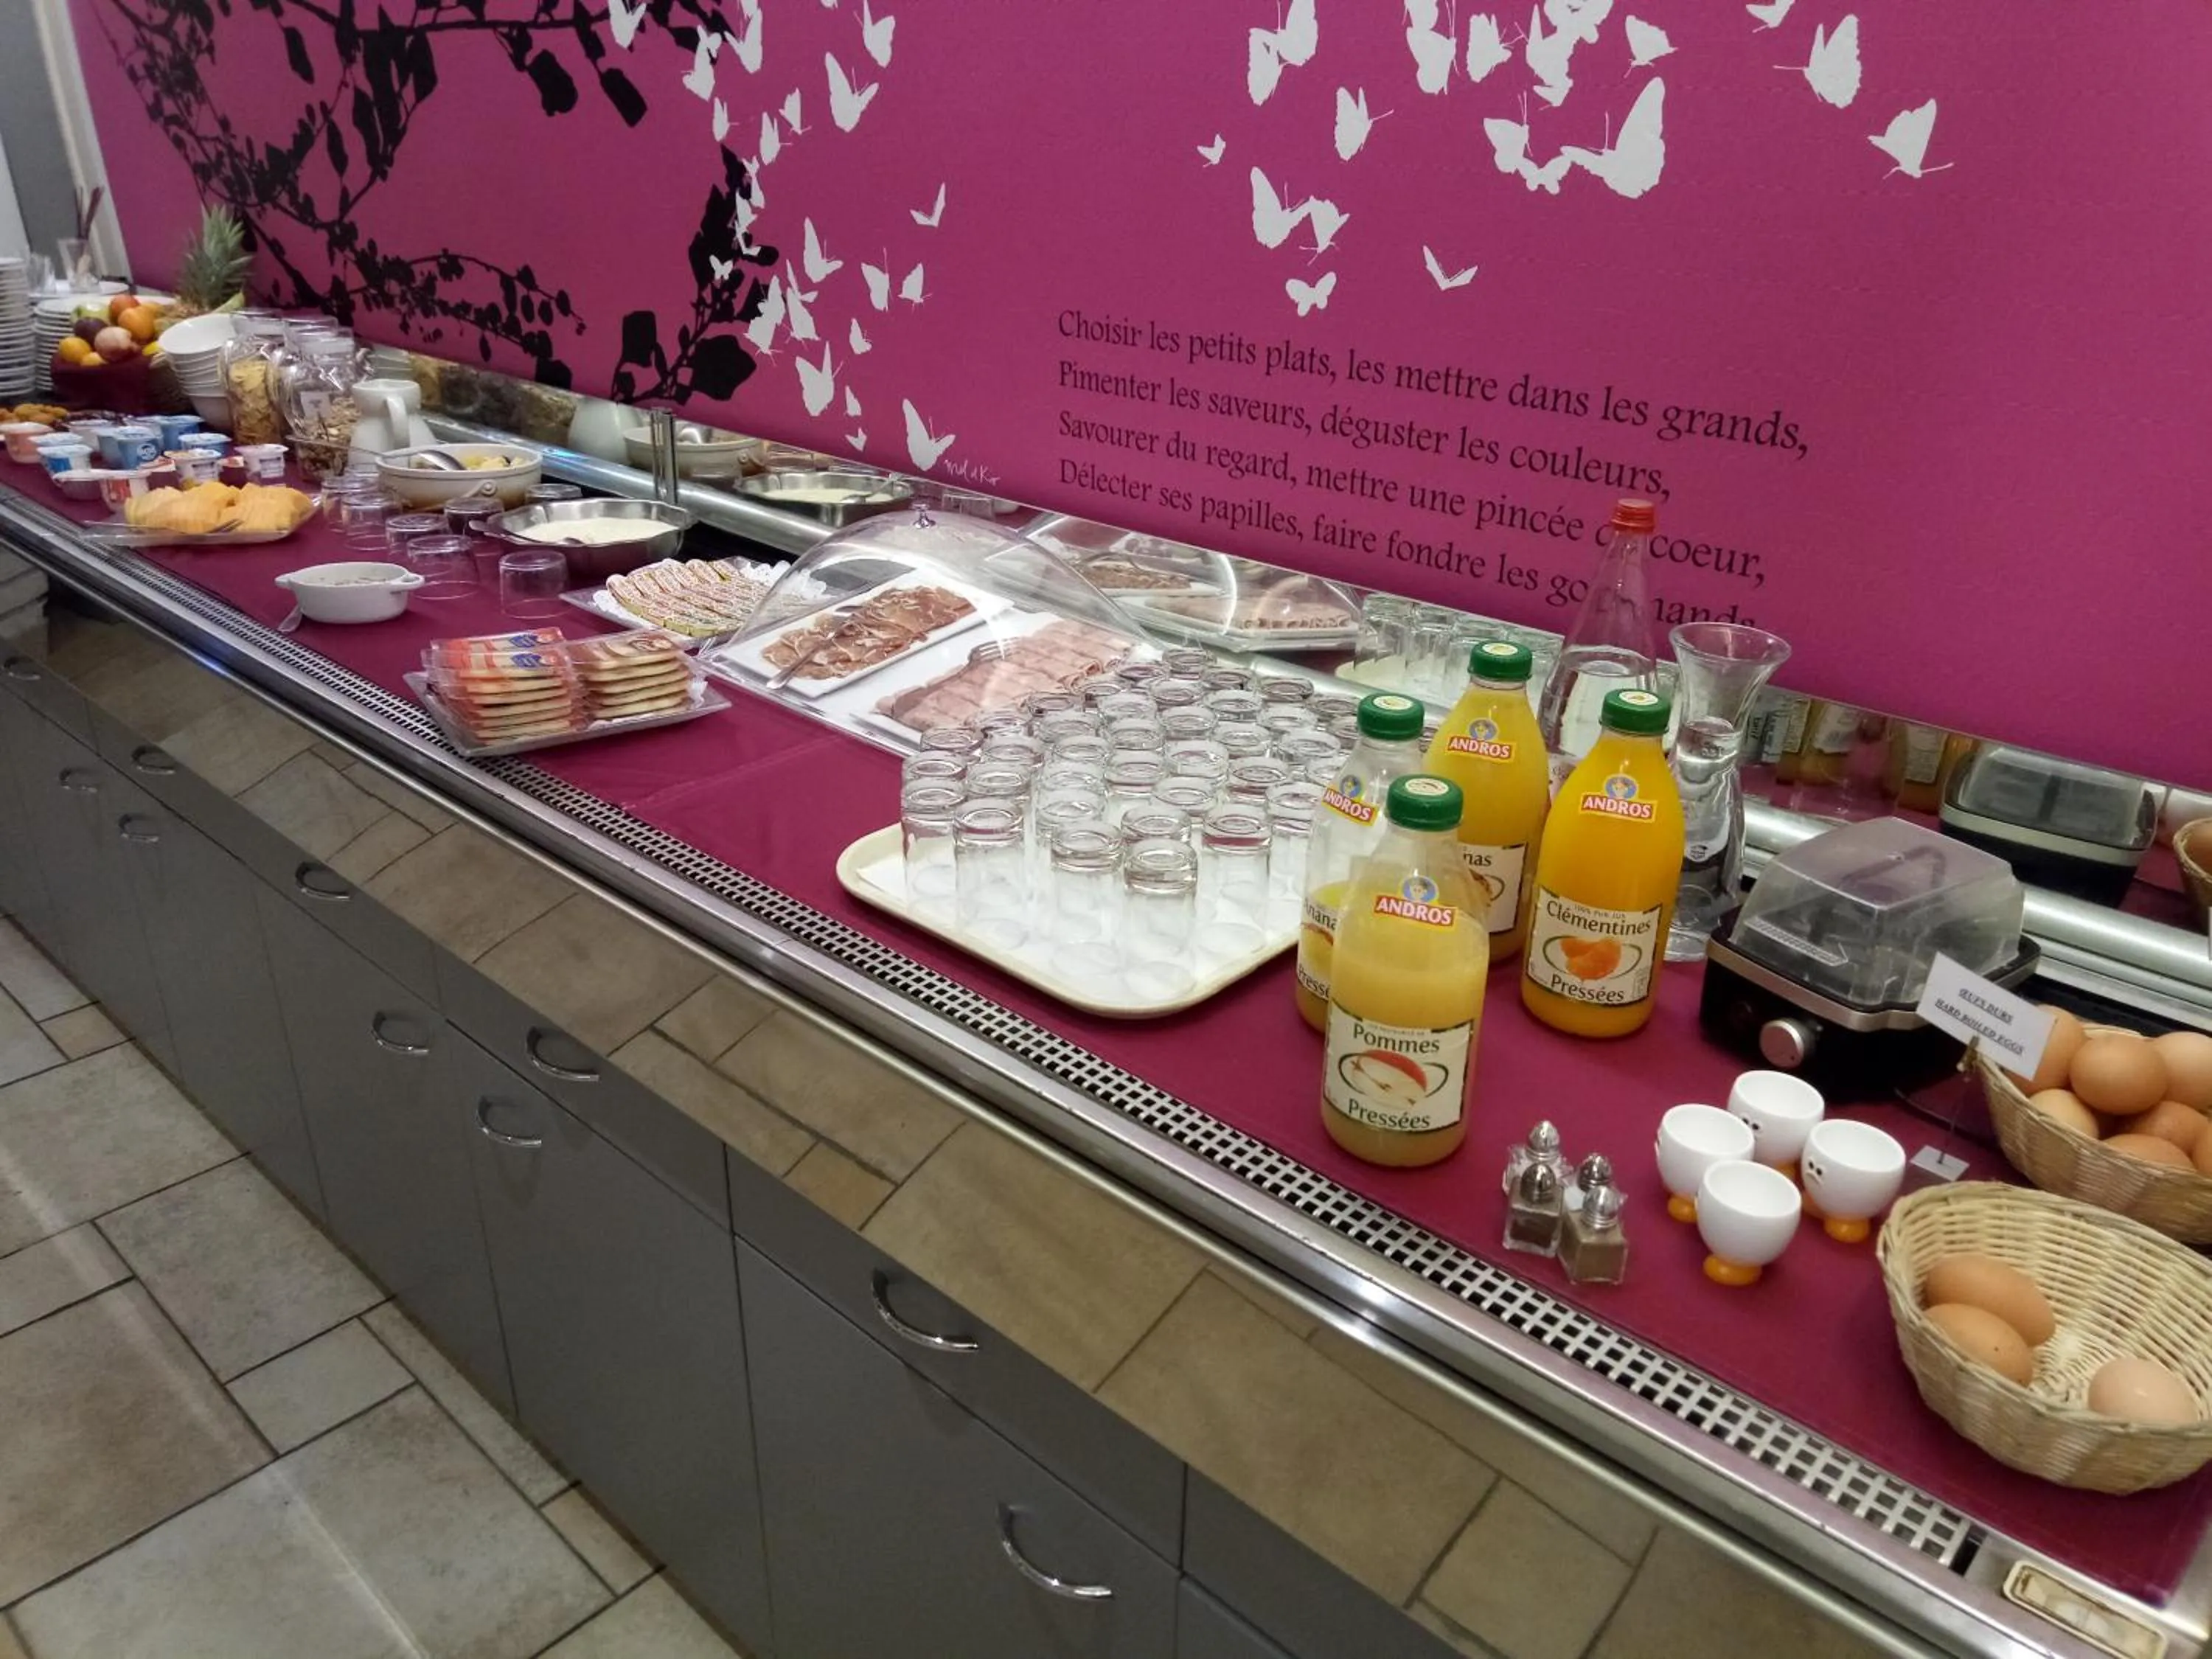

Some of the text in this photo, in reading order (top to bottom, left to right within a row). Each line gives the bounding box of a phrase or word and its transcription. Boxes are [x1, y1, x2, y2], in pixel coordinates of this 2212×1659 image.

[1057, 310, 1809, 461] Choisir les petits plats, les mettre dans les grands,
[1059, 360, 1671, 501] Pimenter les saveurs, déguster les couleurs,
[1059, 410, 1160, 454] Savourer
[1165, 430, 1197, 462] du
[1206, 445, 1298, 487] regard,
[1306, 465, 1399, 504] mettre
[1408, 484, 1466, 518] une
[1474, 494, 1585, 542] pincée
[1649, 535, 1765, 587] coeur,
[1060, 459, 1153, 502] Délecter
[1158, 487, 1192, 512] ses
[1200, 495, 1304, 541] papilles,
[1313, 513, 1377, 554] faire
[1386, 529, 1486, 579] fondre
[1497, 552, 1539, 591] les
[1449, 737, 1511, 758] ANDROS
[1582, 795, 1652, 818] ANDROS
[1376, 896, 1453, 926] ANDROS
[1546, 900, 1652, 936] Clémentines
[1551, 973, 1624, 1002] Pressées
[1934, 998, 1961, 1020] HARD
[1352, 1023, 1441, 1054] Pommes
[1348, 1098, 1431, 1130] Pressées
